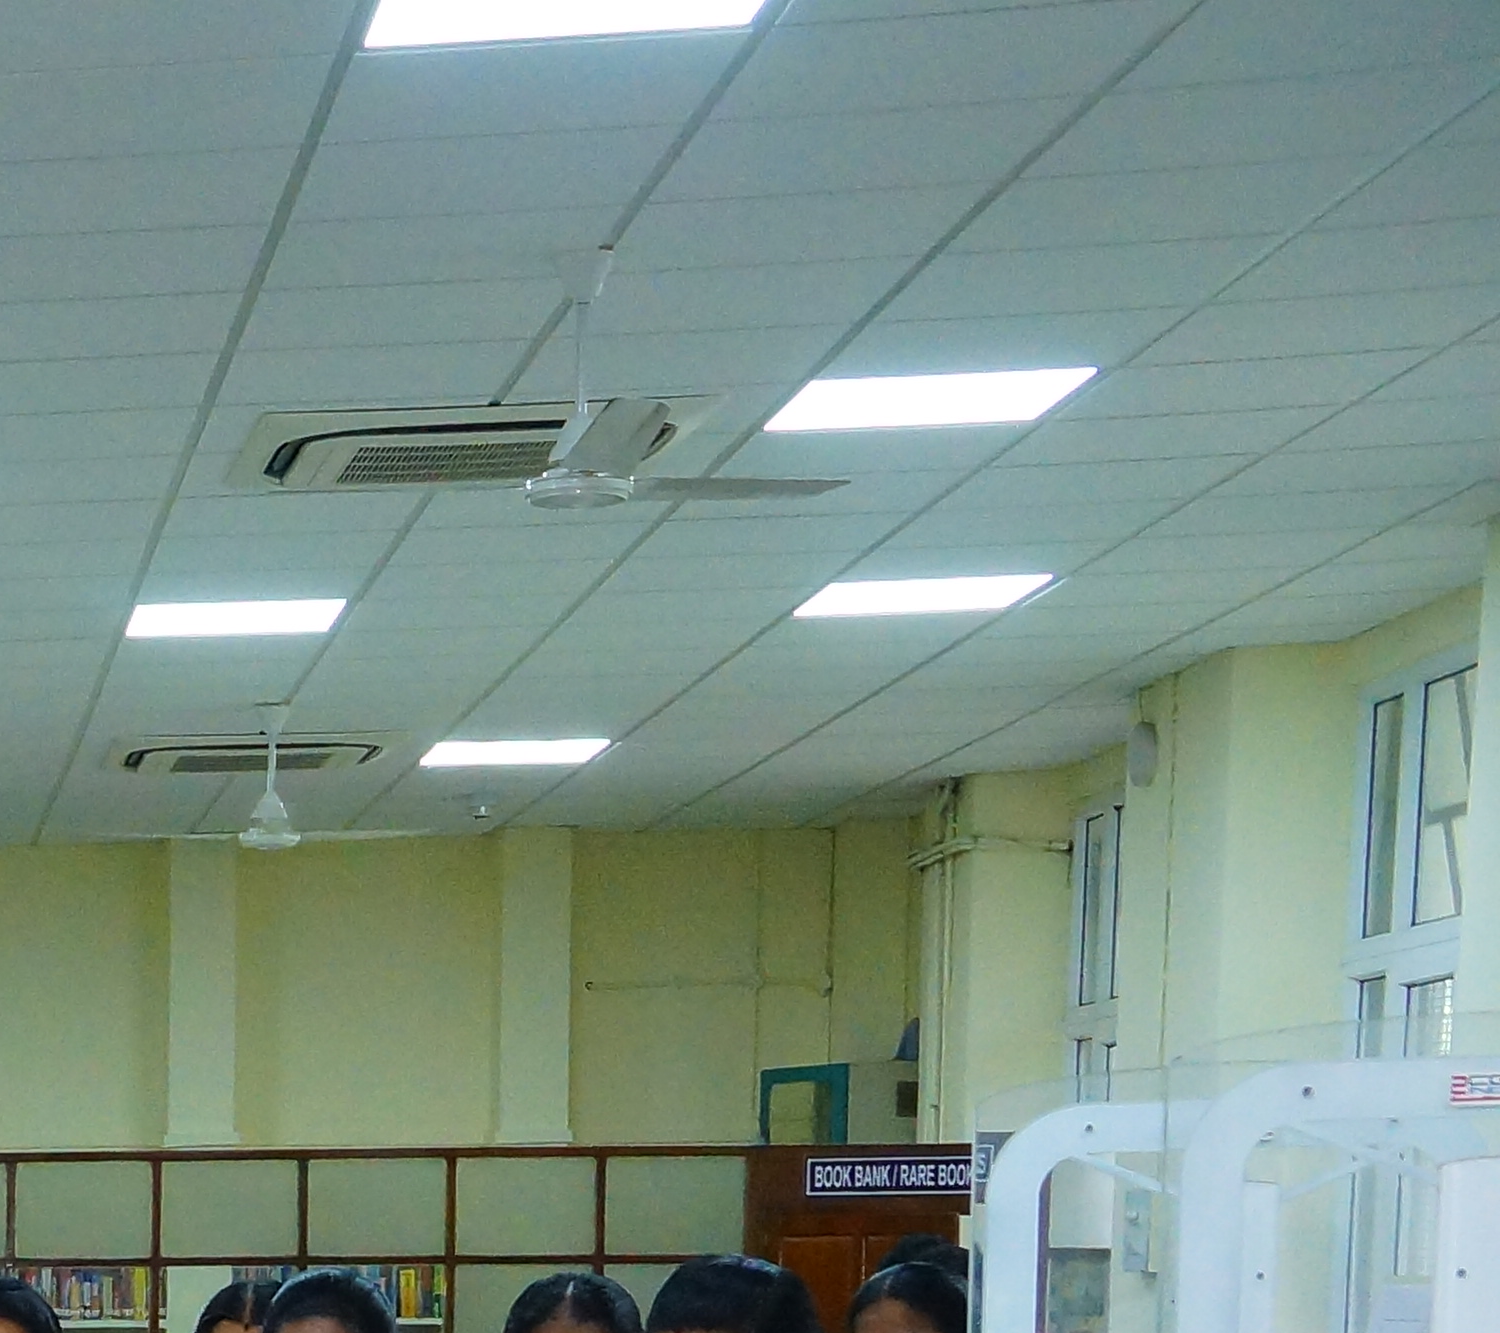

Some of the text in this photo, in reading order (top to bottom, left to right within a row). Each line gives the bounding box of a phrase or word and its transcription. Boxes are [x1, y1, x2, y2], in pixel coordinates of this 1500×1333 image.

[814, 1165, 852, 1188] BOOK
[854, 1164, 891, 1188] BANK
[900, 1164, 935, 1187] RARE
